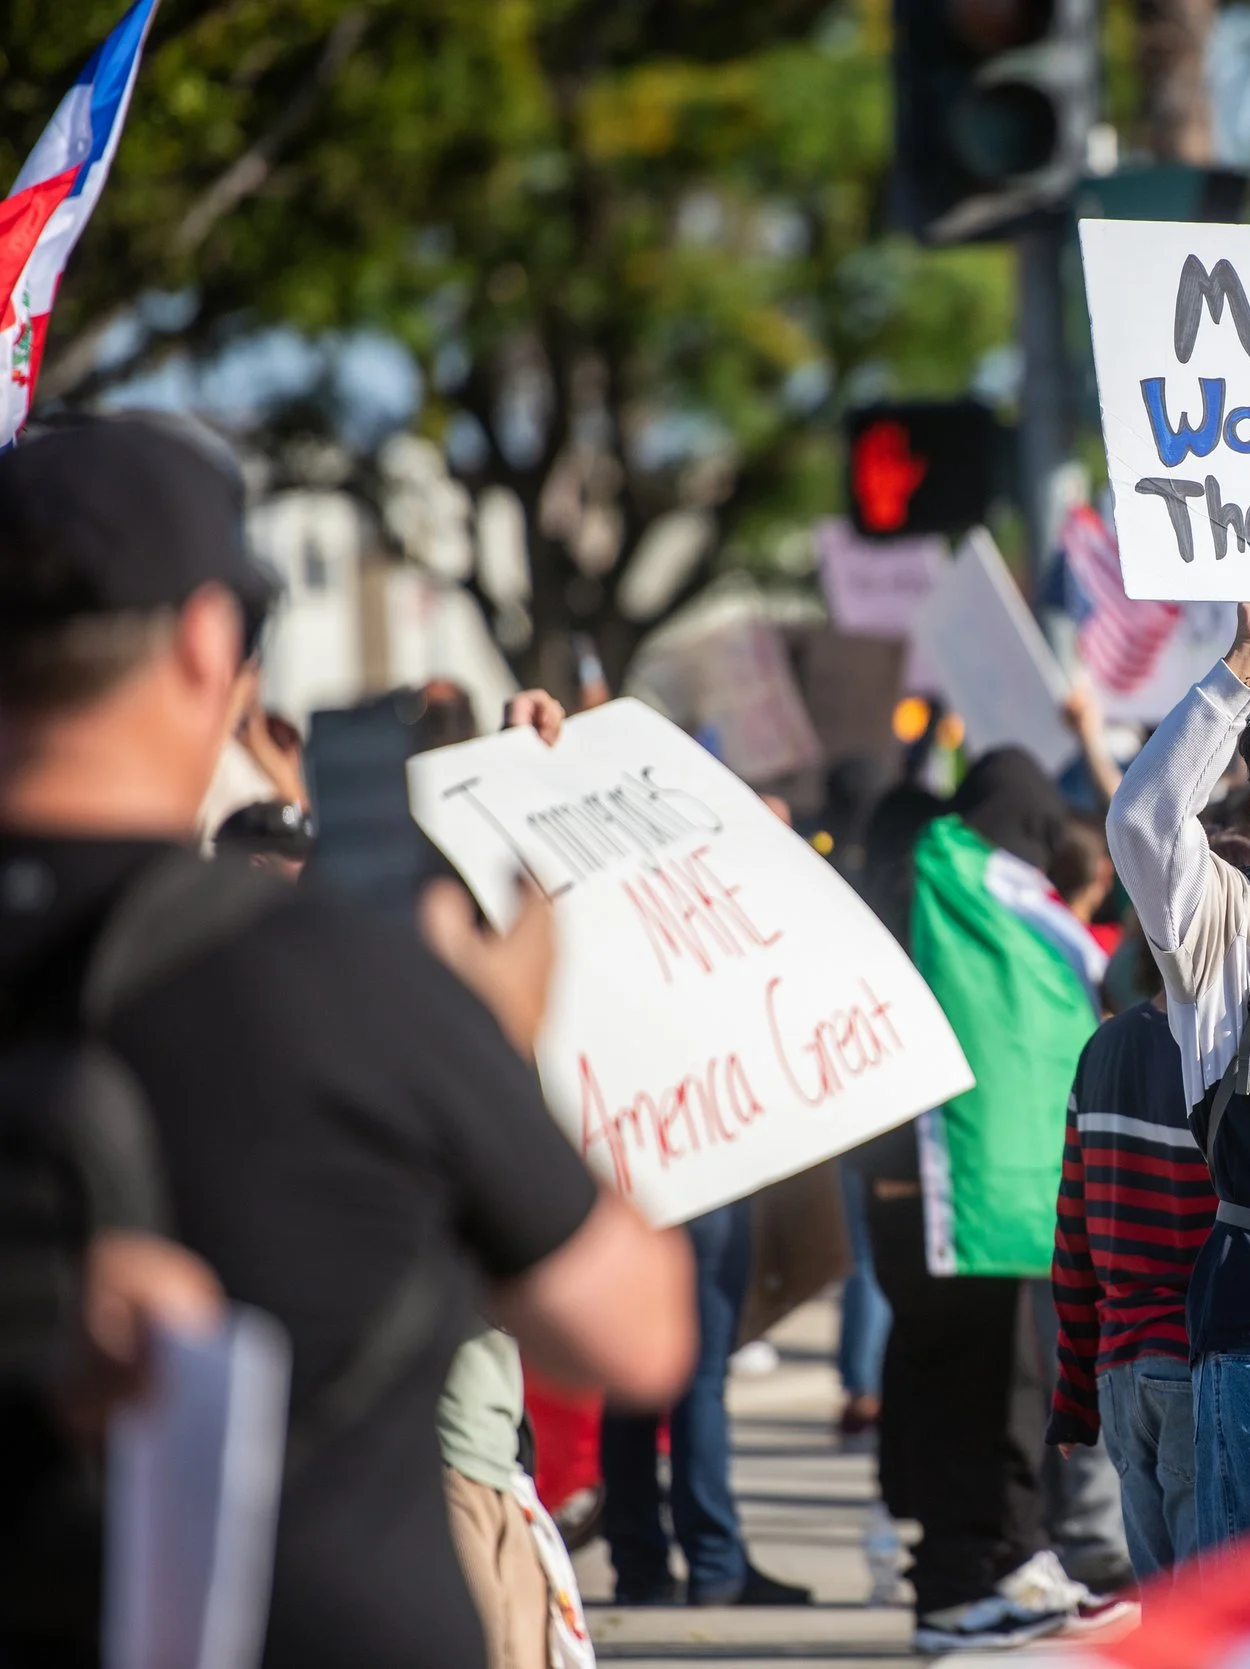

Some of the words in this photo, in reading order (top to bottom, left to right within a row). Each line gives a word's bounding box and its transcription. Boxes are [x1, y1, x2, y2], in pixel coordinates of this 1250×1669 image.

[621, 844, 783, 985] MAKE
[578, 1052, 766, 1194] America
[765, 976, 905, 1108] Great
